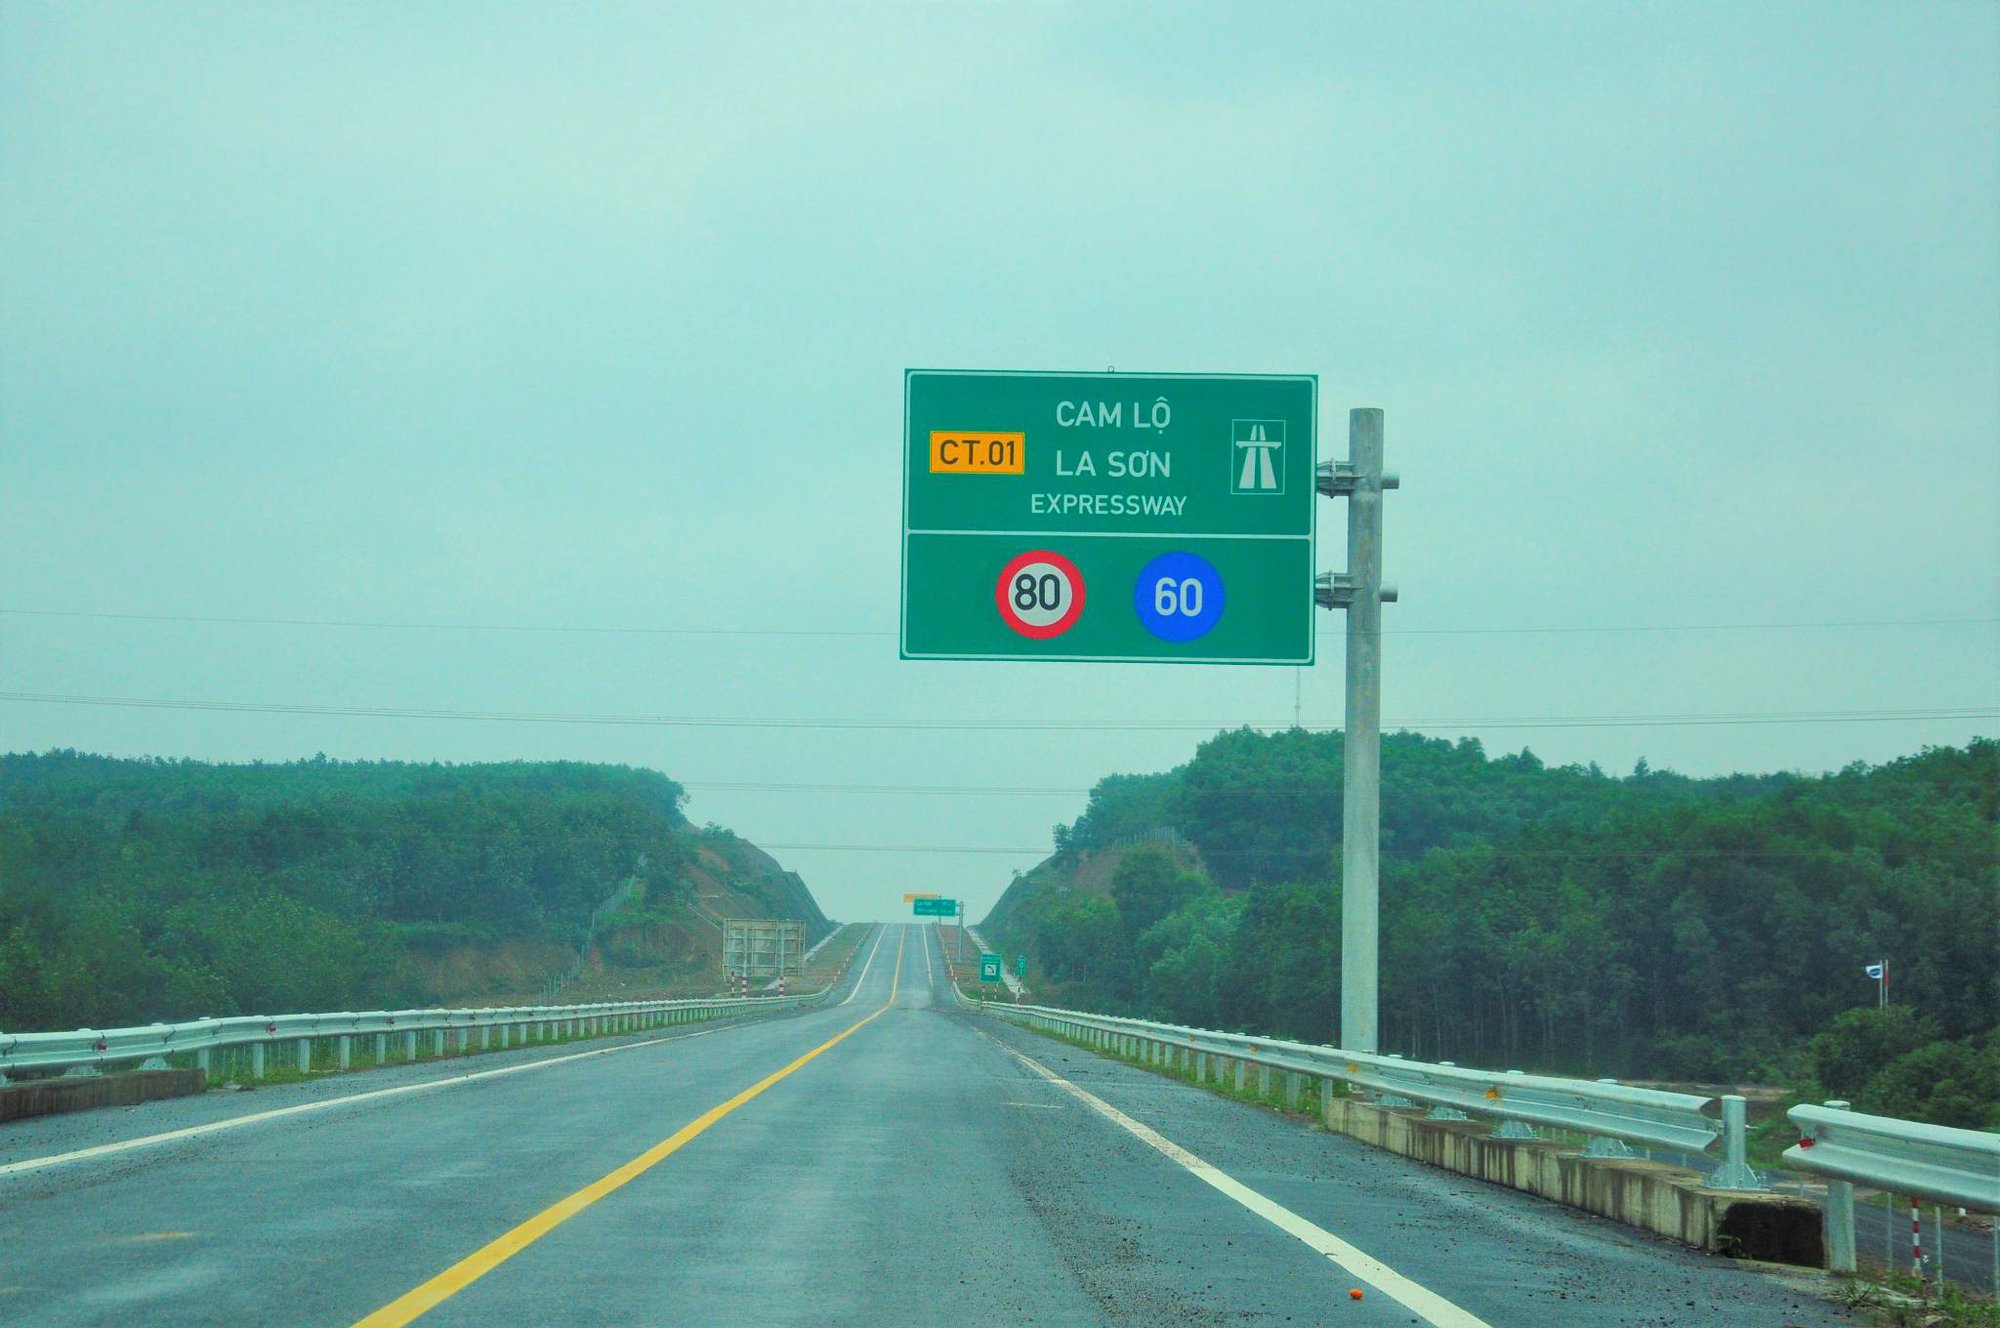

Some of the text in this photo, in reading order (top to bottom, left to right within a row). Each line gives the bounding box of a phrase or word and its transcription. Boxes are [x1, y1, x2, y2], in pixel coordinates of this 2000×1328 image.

[1056, 396, 1171, 435] CAM LỘ
[939, 439, 1015, 466] CT.01
[1056, 450, 1171, 478] LA SƠN
[1031, 493, 1188, 516] EXPRESSWAY
[1014, 573, 1061, 611] 80
[1154, 577, 1203, 617] 60
